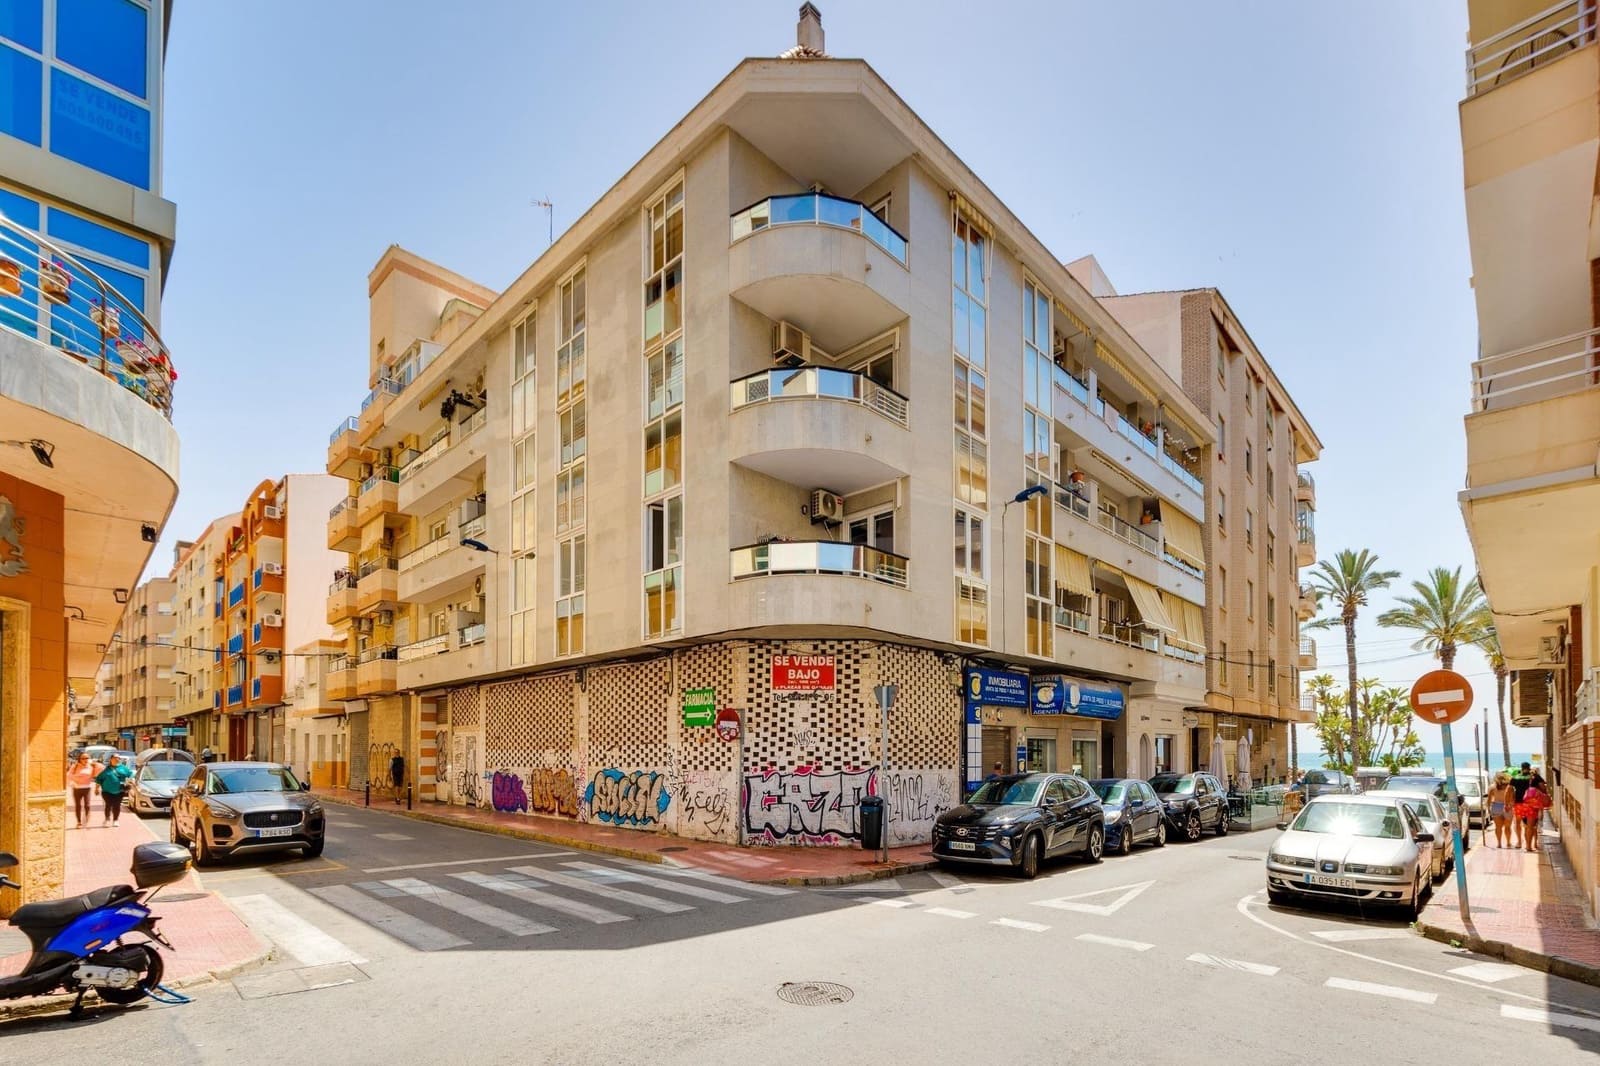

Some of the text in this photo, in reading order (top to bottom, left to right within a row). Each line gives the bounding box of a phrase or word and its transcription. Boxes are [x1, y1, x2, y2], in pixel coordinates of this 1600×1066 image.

[87, 88, 137, 124] VENDE
[774, 655, 834, 666] SE VENDE
[788, 669, 820, 679] BAJO
[988, 676, 1022, 688] INMOBILIARIA
[685, 692, 713, 706] FARMACIA
[1318, 876, 1338, 885] 0351
